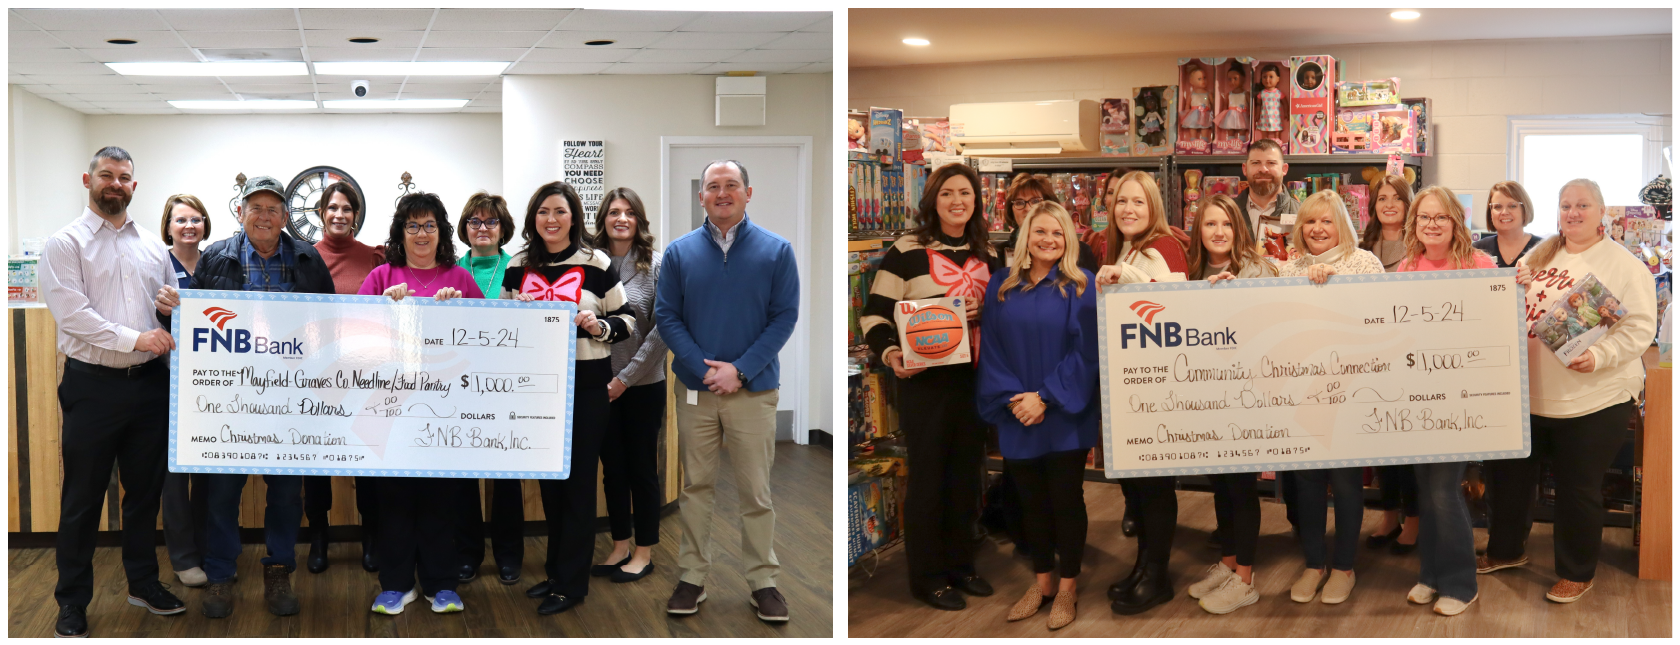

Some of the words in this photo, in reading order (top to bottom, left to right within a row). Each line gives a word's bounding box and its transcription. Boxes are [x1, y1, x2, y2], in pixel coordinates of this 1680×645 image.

[564, 148, 603, 159] Heart
[909, 311, 954, 326] Wilson
[1393, 300, 1464, 323] 12-5-24
[192, 328, 251, 353] FNB
[254, 336, 304, 355] Bank
[452, 328, 519, 348] 12-5-24
[915, 332, 950, 347] NCAA
[1121, 322, 1182, 349] FNB
[1186, 327, 1237, 346] Bank
[1173, 353, 1257, 391] Community
[1260, 355, 1326, 378] Christmas
[1330, 350, 1391, 375] Connection
[1406, 353, 1415, 367] $
[336, 369, 350, 389] Co.
[420, 371, 451, 398] Pantry
[460, 374, 469, 390] $
[196, 395, 223, 413] One
[226, 394, 292, 415] Thousand
[297, 398, 352, 417] Dollars
[1129, 394, 1157, 412] One
[1161, 390, 1231, 411] Thousand
[1234, 390, 1301, 409] Dollars
[1409, 393, 1446, 402] DOLLARS
[1362, 407, 1413, 433] FNB
[220, 424, 283, 443] Christmas
[288, 428, 347, 445] Donation
[414, 423, 462, 447] FNB
[1157, 423, 1223, 443] Christmas
[1228, 423, 1291, 441] Donation
[852, 491, 861, 533] SCAVENGER
